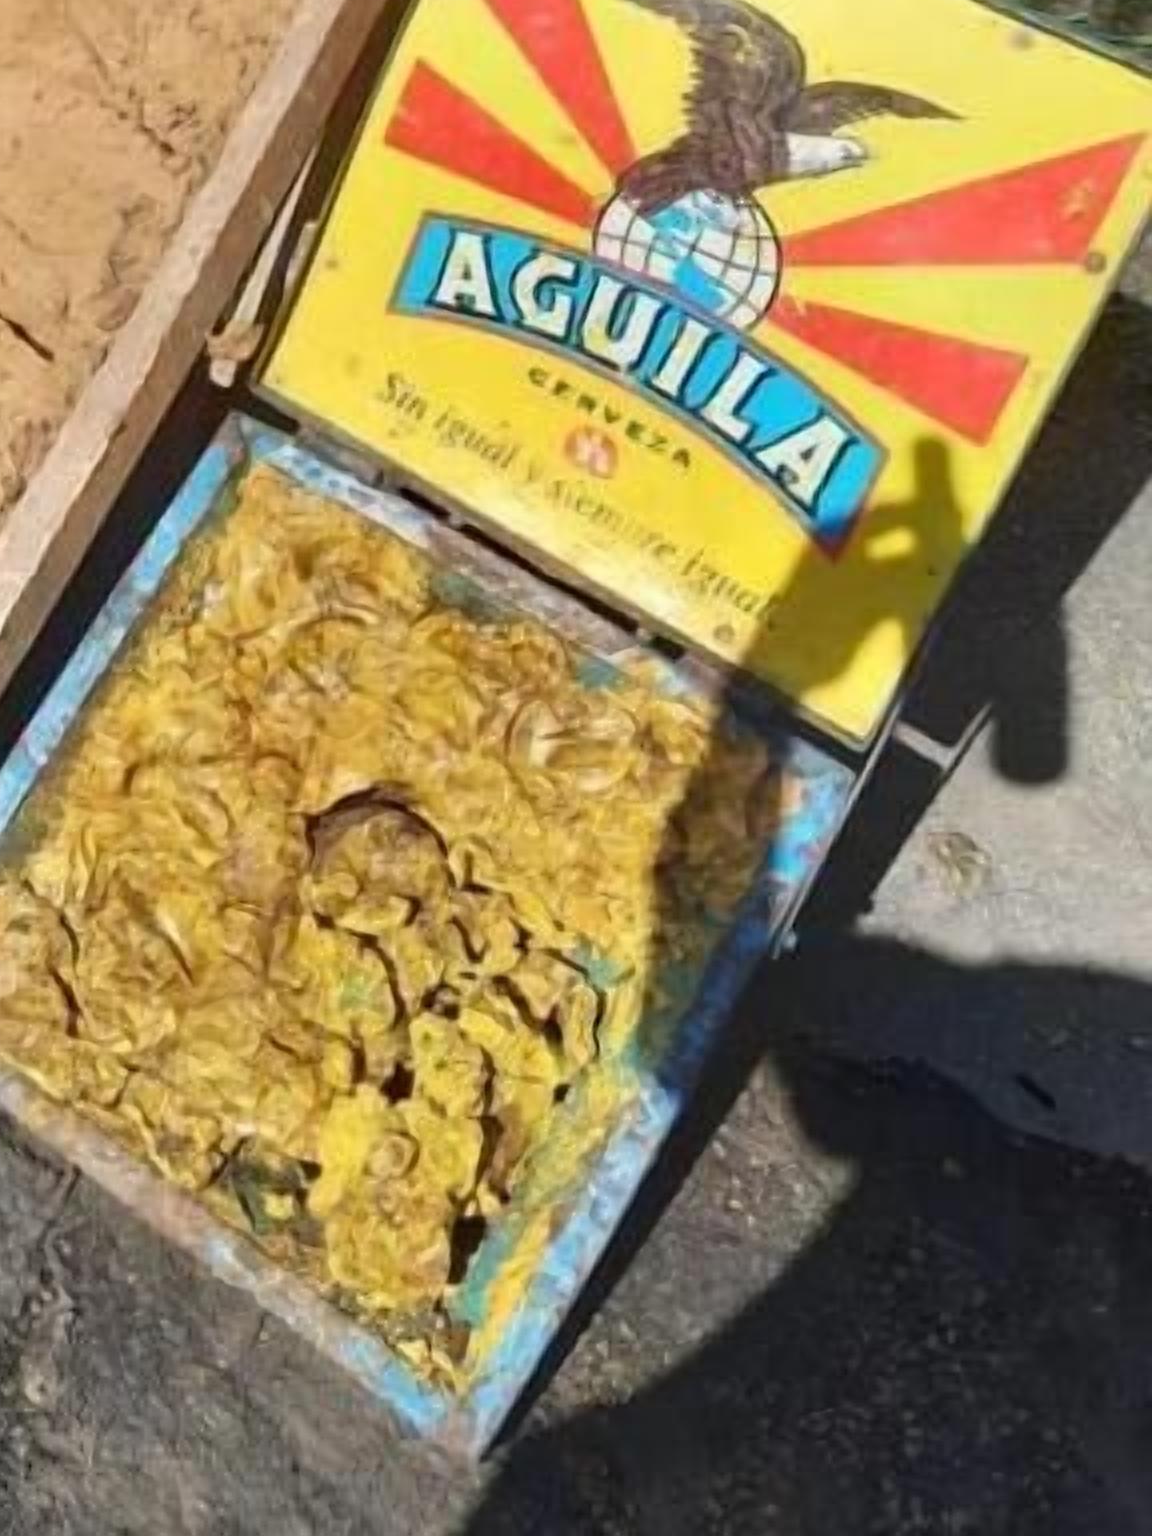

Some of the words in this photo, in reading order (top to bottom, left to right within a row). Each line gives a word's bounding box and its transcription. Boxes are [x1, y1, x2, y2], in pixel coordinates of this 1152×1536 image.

[377, 371, 428, 421] Sin
[432, 228, 856, 516] AGUILA
[527, 367, 691, 469] CERVEZA
